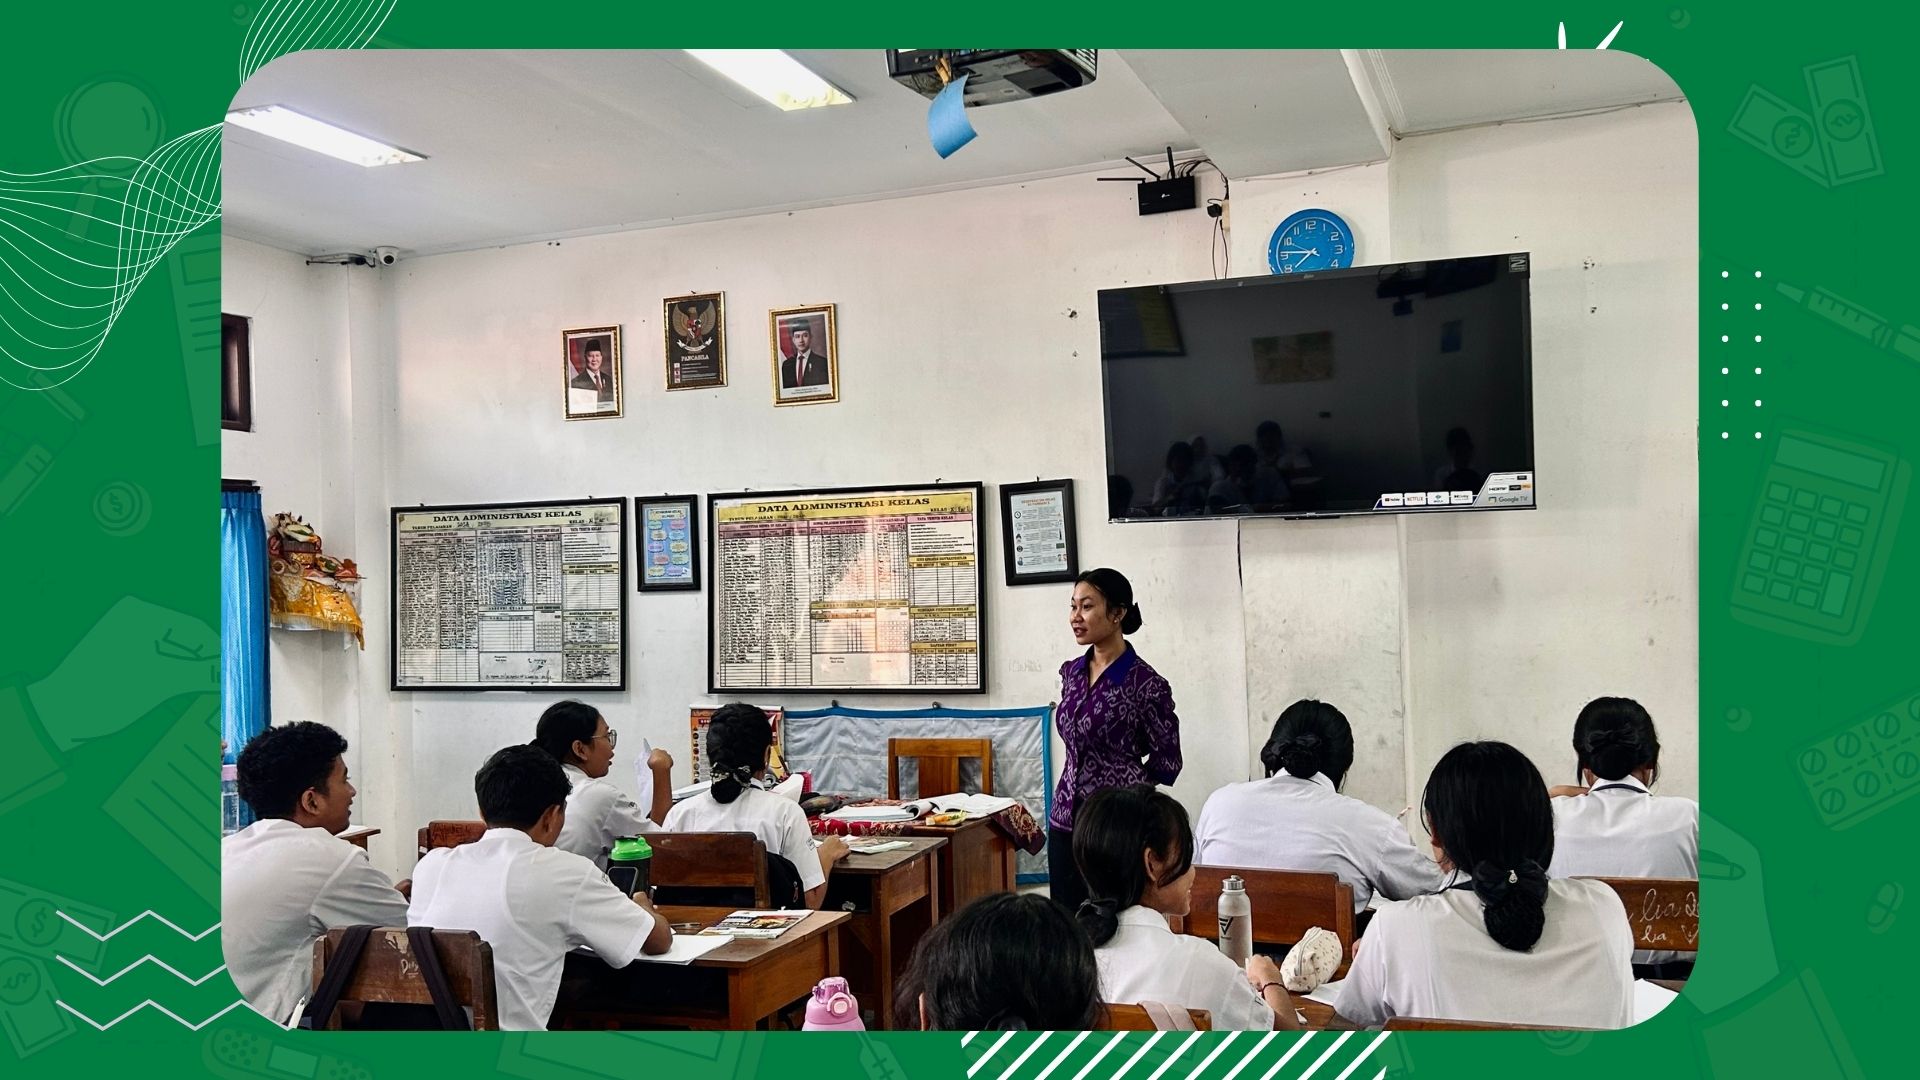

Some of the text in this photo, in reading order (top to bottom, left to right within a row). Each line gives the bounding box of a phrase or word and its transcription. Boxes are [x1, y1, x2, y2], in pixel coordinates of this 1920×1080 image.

[1305, 220, 1316, 230] 12
[1293, 226, 1299, 235] 11
[1330, 231, 1339, 241] 2
[1283, 237, 1291, 246] 10
[1334, 244, 1343, 255] 3
[1330, 258, 1339, 268] 4
[1284, 264, 1292, 273] 8
[681, 354, 710, 362] PANCASILA
[792, 500, 884, 511] ADMINISTRASI
[888, 498, 930, 506] KELAS
[433, 510, 582, 523] DATA ADMINISTRASI KELAS
